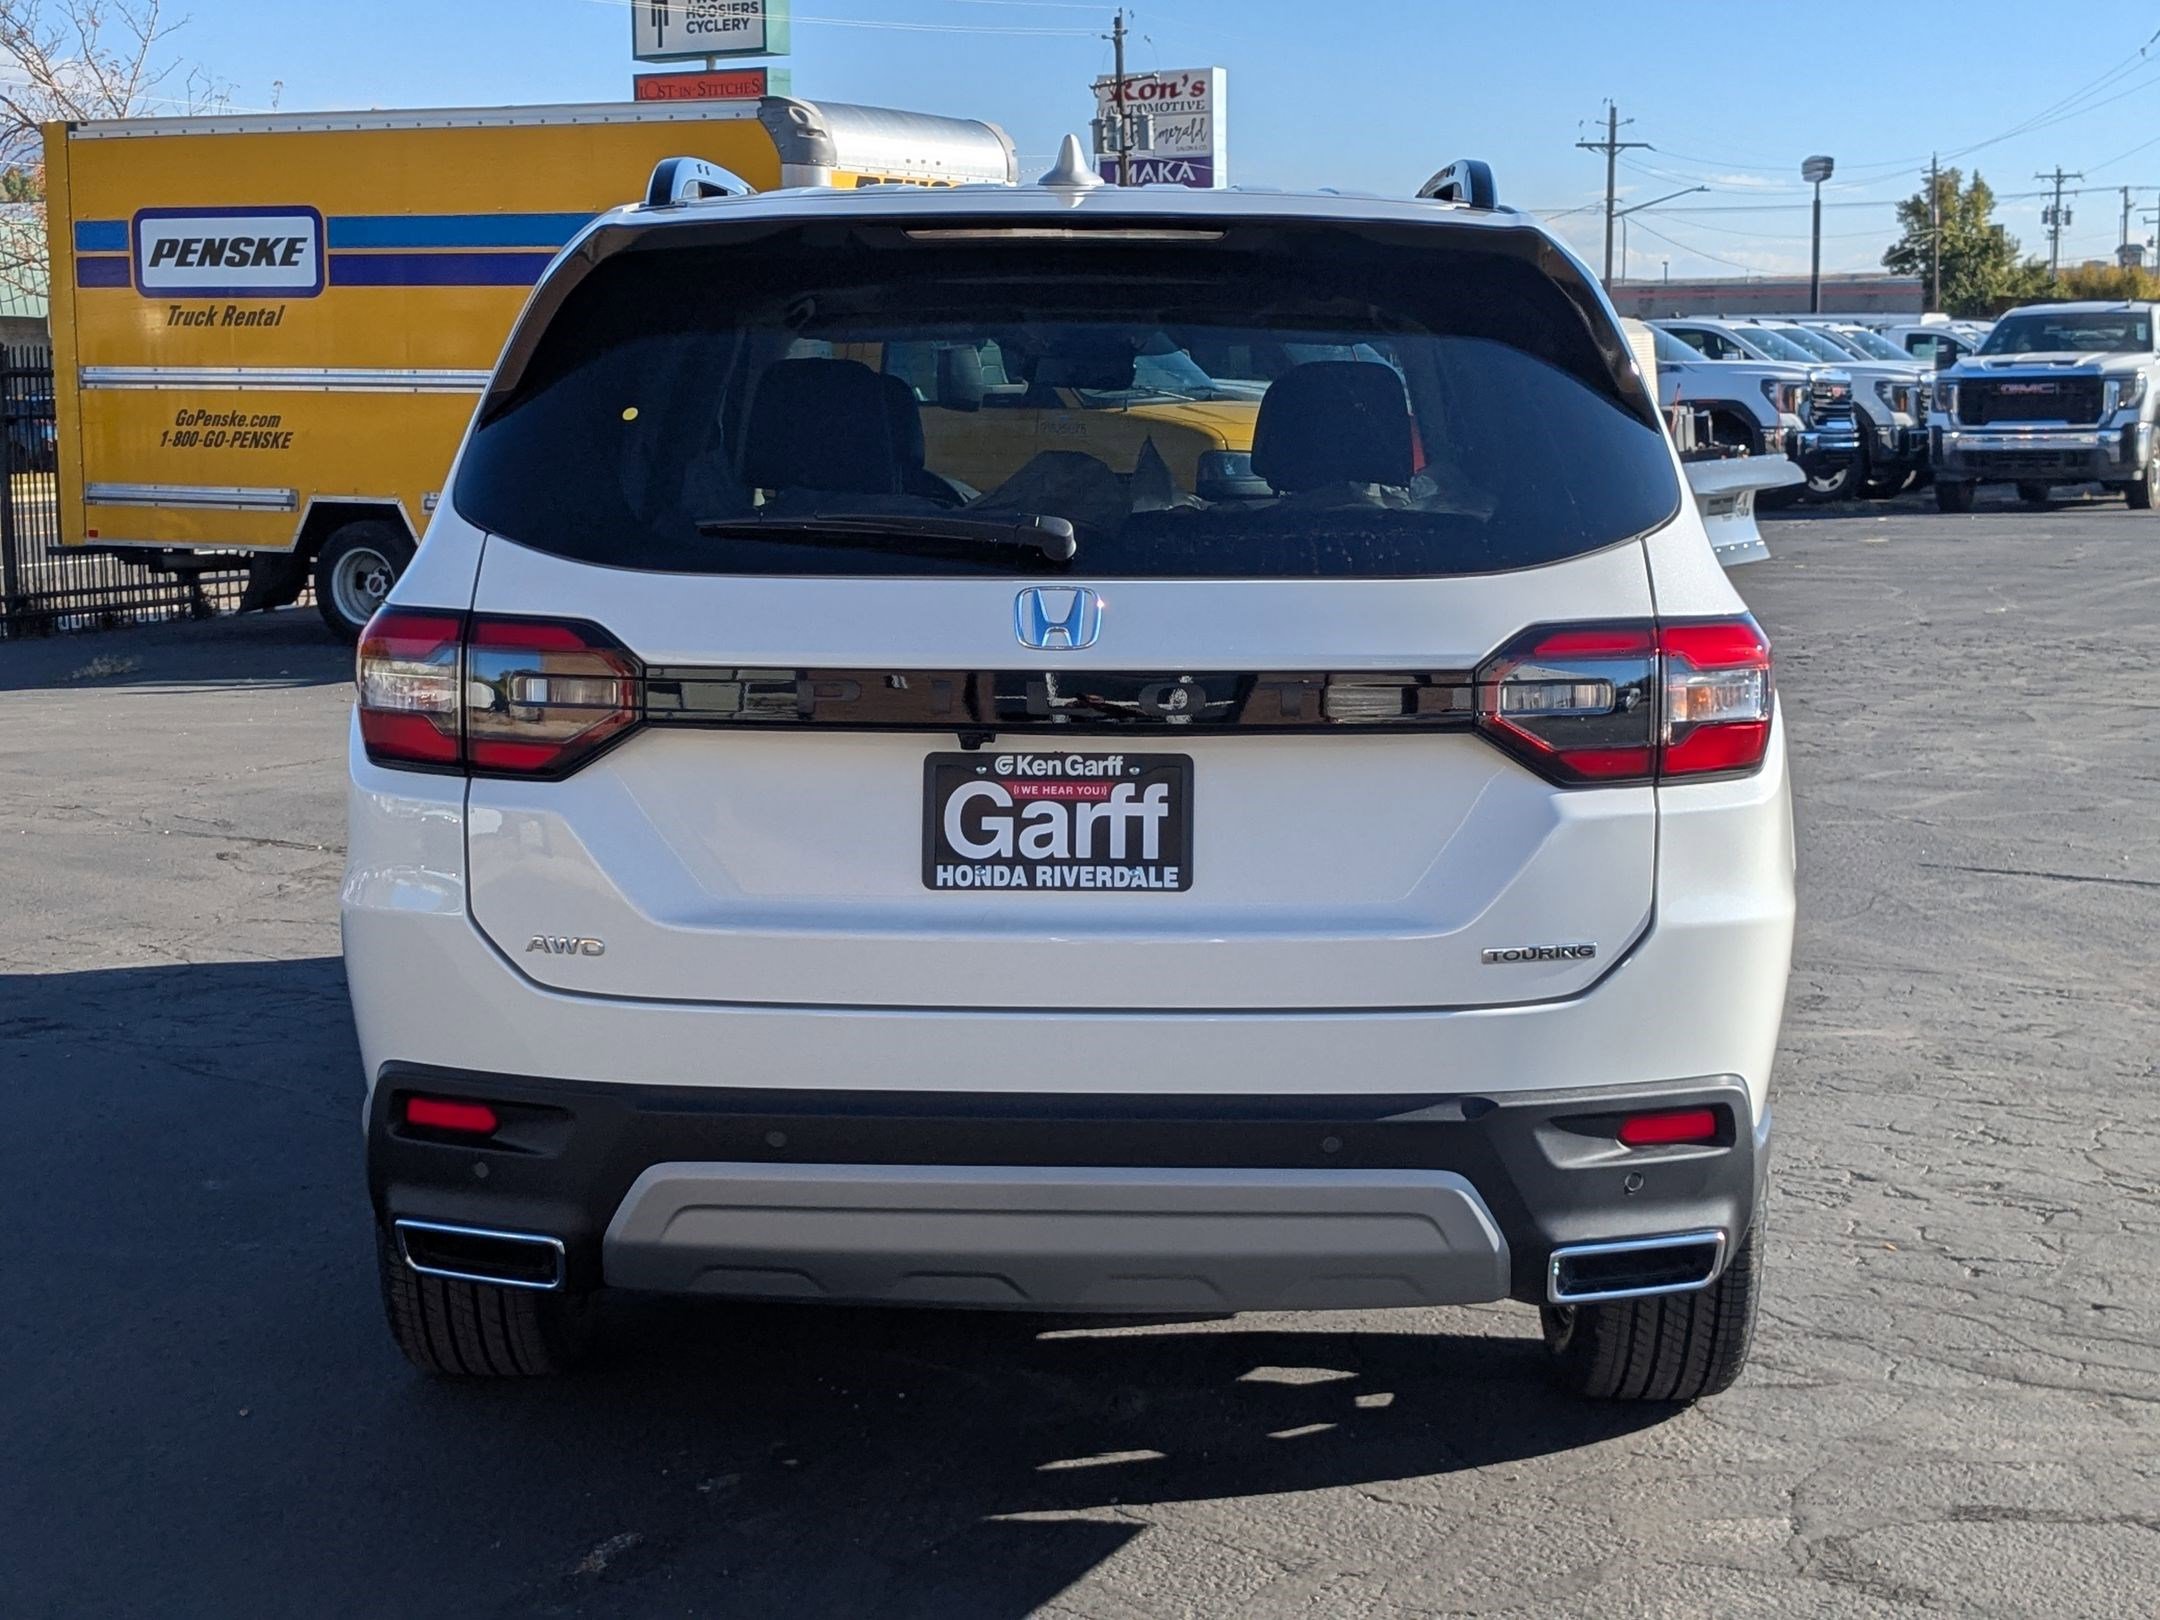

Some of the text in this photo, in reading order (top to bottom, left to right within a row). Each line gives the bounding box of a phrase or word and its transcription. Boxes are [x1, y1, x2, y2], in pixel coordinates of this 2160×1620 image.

[686, 2, 759, 20] HOOSIERS
[686, 18, 751, 35] CYCLERY
[148, 236, 308, 268] PENSKE
[167, 304, 286, 327] Truck Rental
[175, 408, 282, 428] GoPenske.com
[160, 430, 294, 449] 1-800-GO-PENSKE
[1017, 755, 1123, 776] Ken Garff
[1021, 786, 1102, 796] WE HEAR YOU
[943, 780, 1169, 860] Garff
[936, 864, 1179, 888] HONDA RIVERDALE
[525, 934, 606, 956] AWD
[1488, 944, 1594, 962] TOURING
